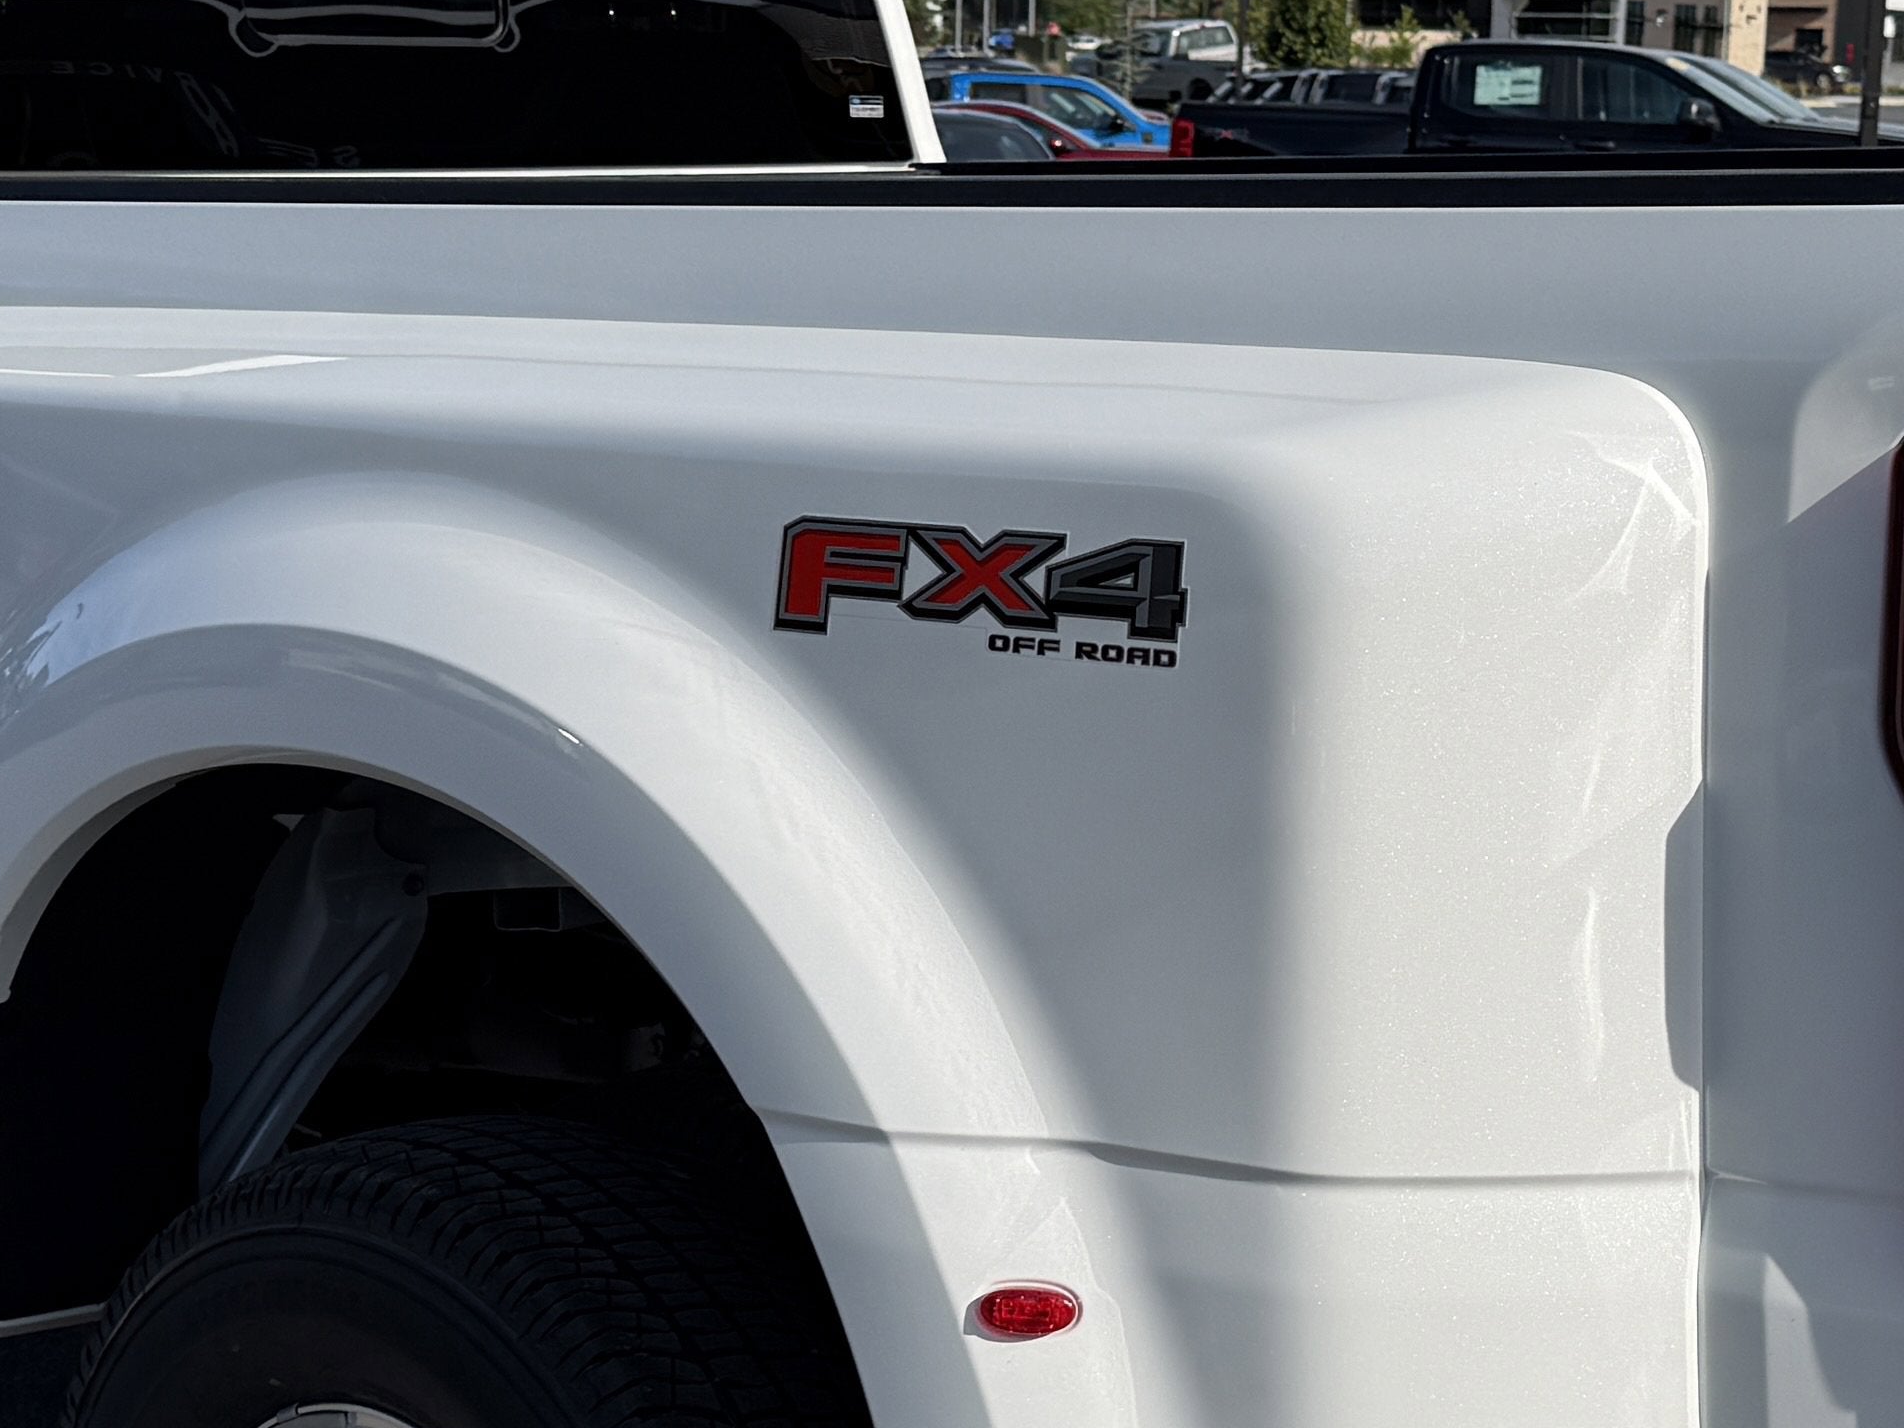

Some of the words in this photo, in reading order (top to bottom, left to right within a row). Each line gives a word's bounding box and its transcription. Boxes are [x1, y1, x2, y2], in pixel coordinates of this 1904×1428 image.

[773, 514, 1189, 644] FX4
[987, 632, 1062, 657] OFF
[1074, 640, 1179, 669] ROAD
